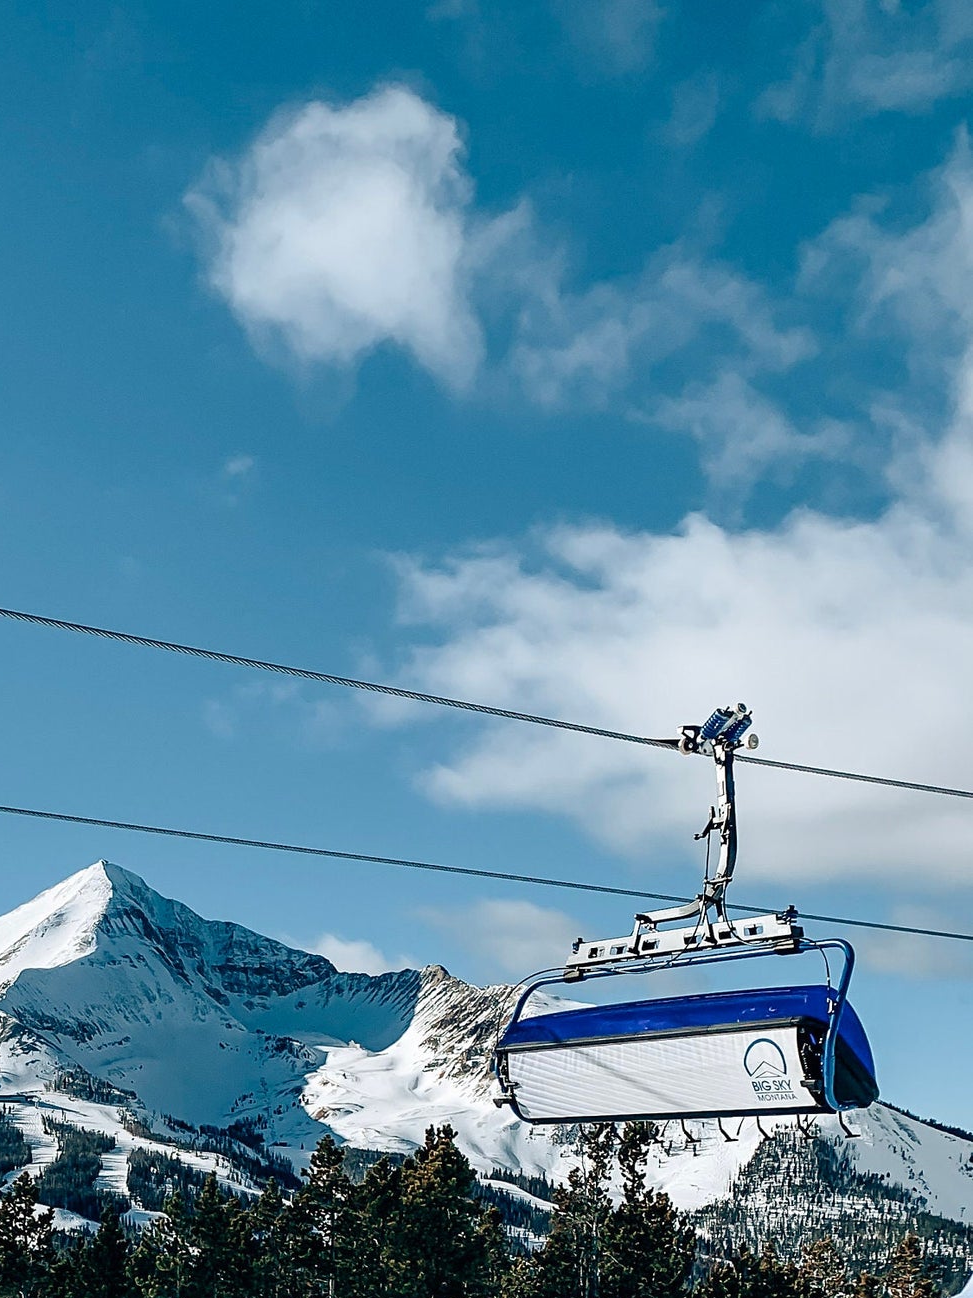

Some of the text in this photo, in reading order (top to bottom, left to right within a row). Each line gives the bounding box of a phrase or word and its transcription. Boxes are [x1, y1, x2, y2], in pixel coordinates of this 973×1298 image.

[751, 1079, 792, 1092] BIG SKY
[757, 1093, 798, 1101] MONTANA
